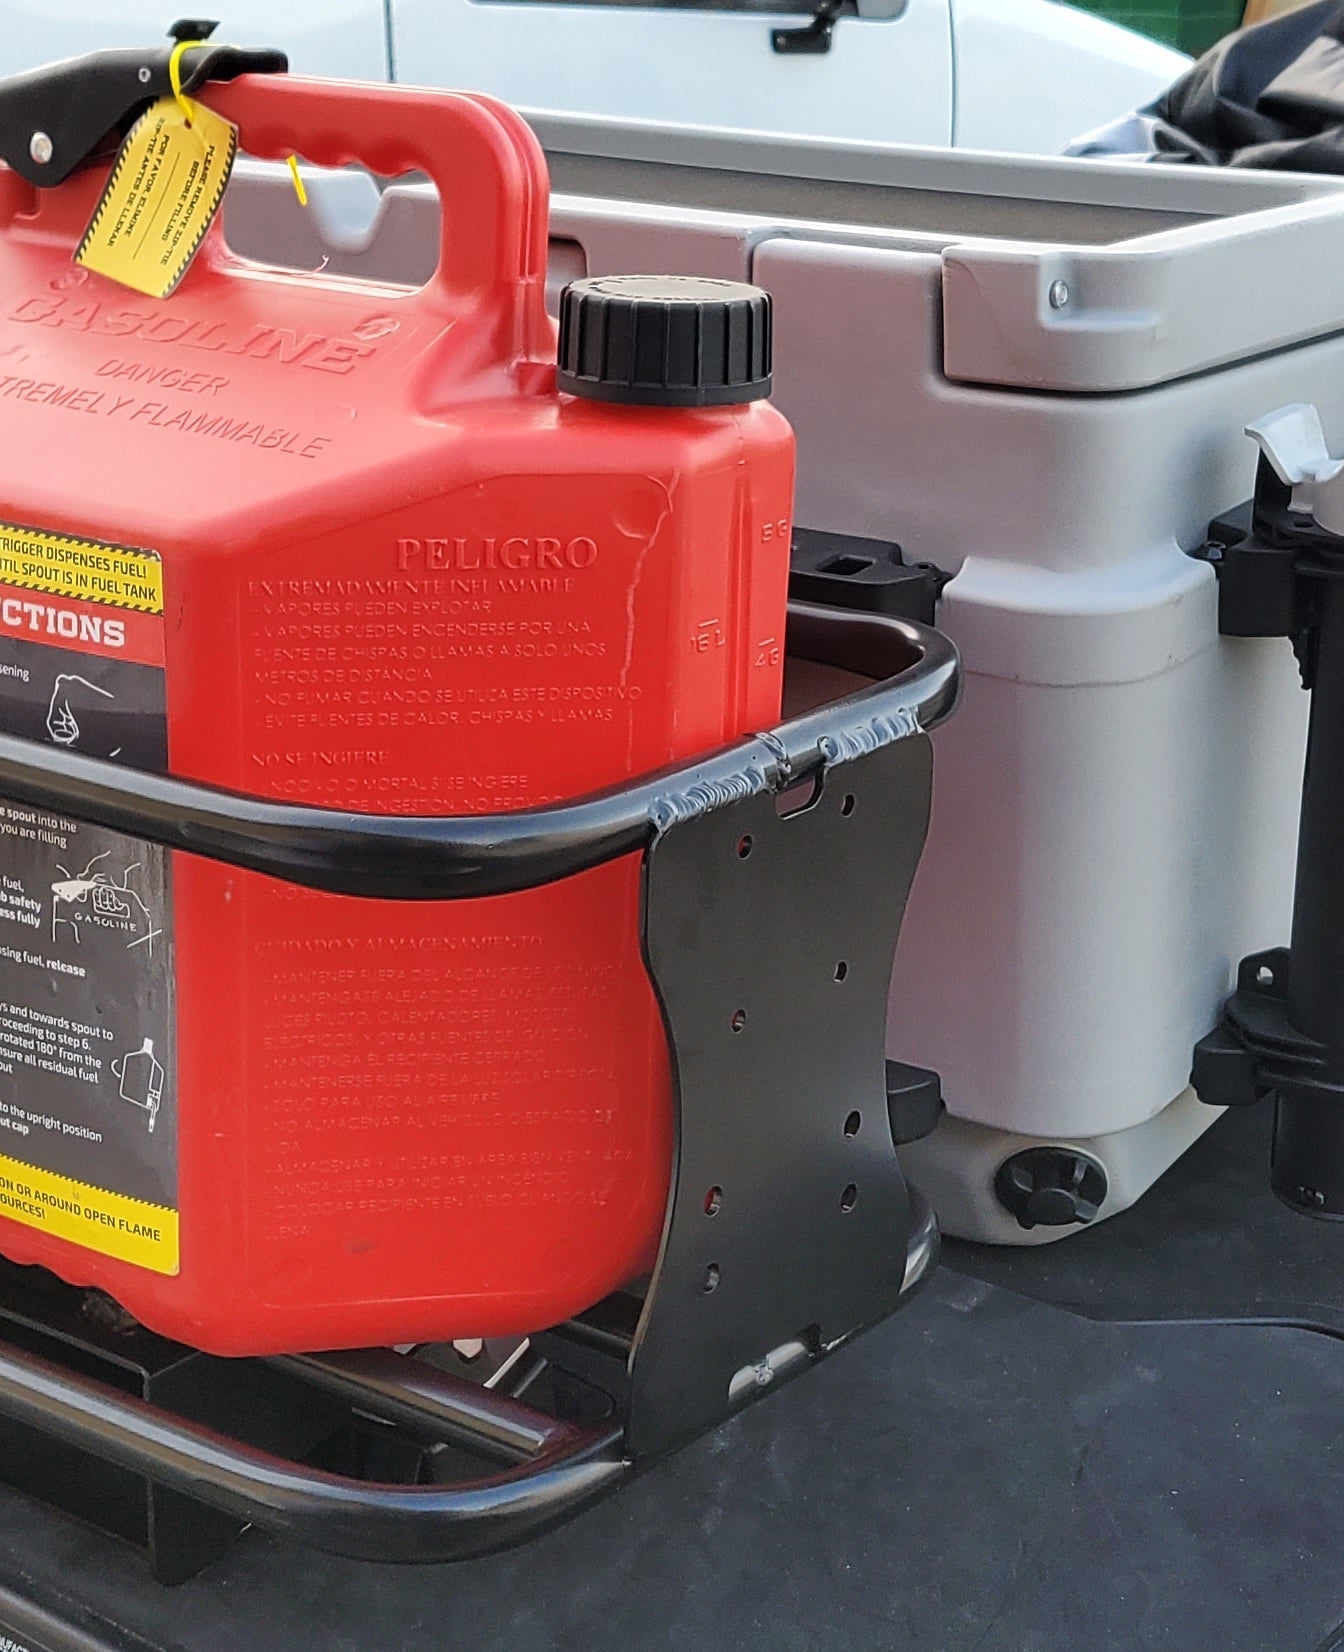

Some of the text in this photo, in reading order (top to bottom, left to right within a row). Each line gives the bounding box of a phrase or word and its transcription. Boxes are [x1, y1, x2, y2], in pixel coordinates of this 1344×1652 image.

[159, 134, 170, 157] POR
[134, 155, 149, 191] ANTES
[127, 192, 137, 207] DE
[161, 145, 215, 266] PLEASE REMOVE ZIP-TIE
[162, 161, 199, 241] BEFORE FILLING
[107, 208, 128, 247] LLENAR
[126, 197, 146, 236] ELIMINE
[7, 297, 377, 375] GASOLINE
[93, 358, 231, 396] DANGER
[129, 402, 333, 460] FLAMMABLE
[46, 548, 110, 571] DISPENSES
[113, 561, 147, 579] FUEL!
[397, 537, 598, 570] PELIGRO
[22, 563, 59, 581] SPOUT
[62, 571, 73, 584] IS
[75, 573, 88, 588] IN
[91, 577, 121, 594] FUEL
[123, 583, 157, 602] TANK
[0, 820, 18, 836] you
[19, 827, 37, 840] are
[38, 830, 67, 848] filling
[7, 806, 36, 825] spout
[38, 814, 58, 830] into
[59, 817, 77, 833] the
[3, 875, 24, 892] fuel,
[9, 892, 42, 912] safety
[17, 907, 41, 928] fully
[74, 912, 137, 932] GASOLINE
[23, 950, 45, 968] fuel,
[46, 956, 86, 977] release
[9, 1004, 28, 1018] and
[29, 1010, 70, 1030] towards
[71, 1022, 101, 1040] spout
[102, 1028, 114, 1041] to
[0, 1030, 35, 1050] rotated
[58, 1047, 83, 1064] from
[84, 1055, 102, 1069] the
[45, 1029, 56, 1041] to
[57, 1032, 81, 1049] step
[81, 1038, 92, 1051] 6.
[24, 1052, 37, 1066] all
[38, 1058, 78, 1079] residual
[78, 1066, 100, 1084] fuel
[0, 1100, 9, 1113] to
[10, 1104, 26, 1119] the
[26, 1110, 61, 1132] upright
[62, 1121, 102, 1144] position
[12, 1121, 29, 1136] cap
[16, 1183, 32, 1199] OR
[34, 1189, 81, 1217] AROUND
[84, 1207, 116, 1228] OPEN
[118, 1218, 161, 1243] FLAME
